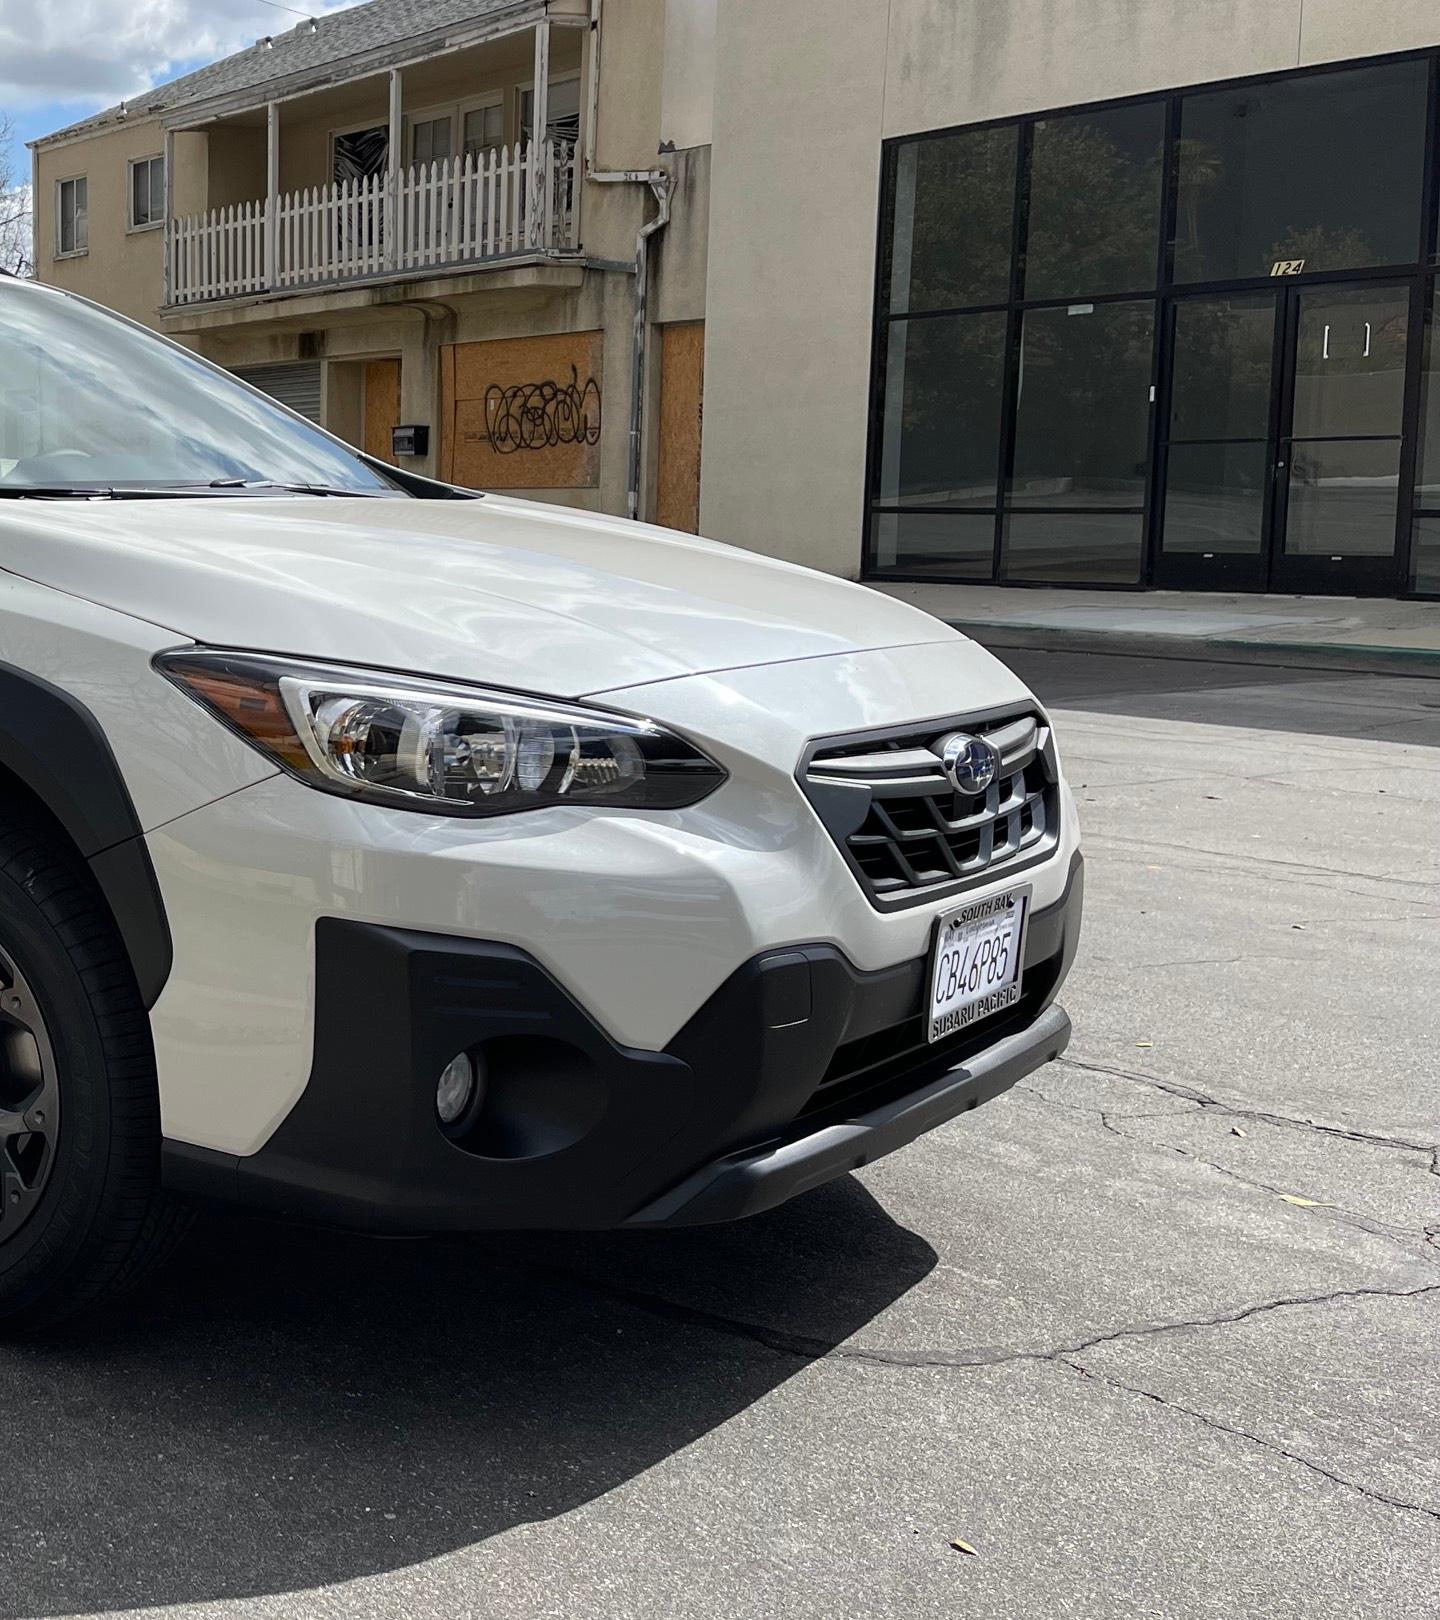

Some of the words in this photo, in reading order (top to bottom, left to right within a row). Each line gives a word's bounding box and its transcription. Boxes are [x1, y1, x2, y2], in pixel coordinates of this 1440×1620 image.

[1275, 261, 1302, 275] 124
[961, 900, 993, 922] SOUTH
[994, 893, 1013, 911] BAY
[936, 931, 1012, 1004] CB46P85
[932, 1004, 975, 1038] SUBARU
[978, 985, 1017, 1016] PACIFIC
